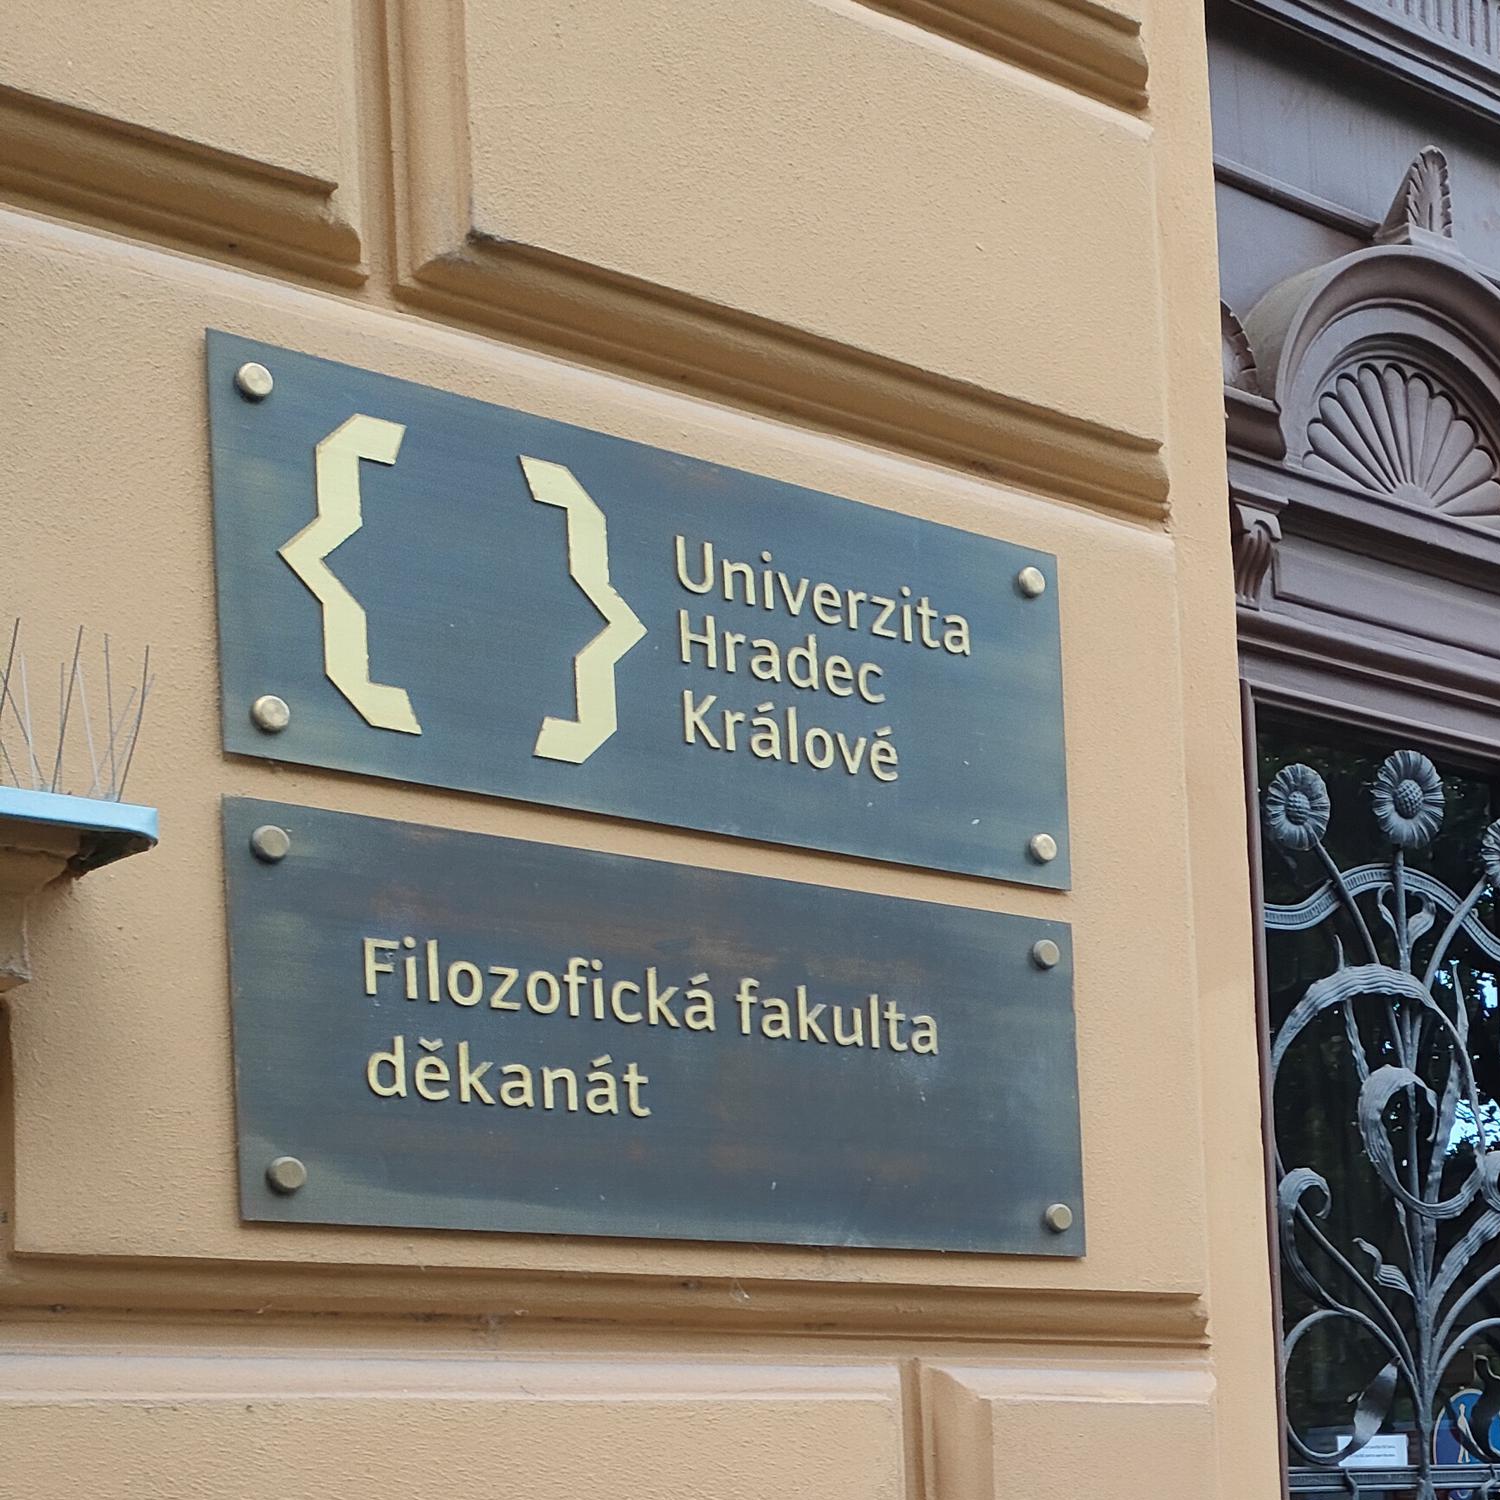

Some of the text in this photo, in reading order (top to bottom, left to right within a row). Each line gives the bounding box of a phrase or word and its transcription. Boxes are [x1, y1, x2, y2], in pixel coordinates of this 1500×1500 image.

[676, 535, 971, 656] Univerzita
[678, 609, 886, 705] Hradec
[683, 690, 899, 782] Králové
[363, 936, 939, 1055] Filozofická fakulta
[366, 1035, 651, 1119] děkanát
